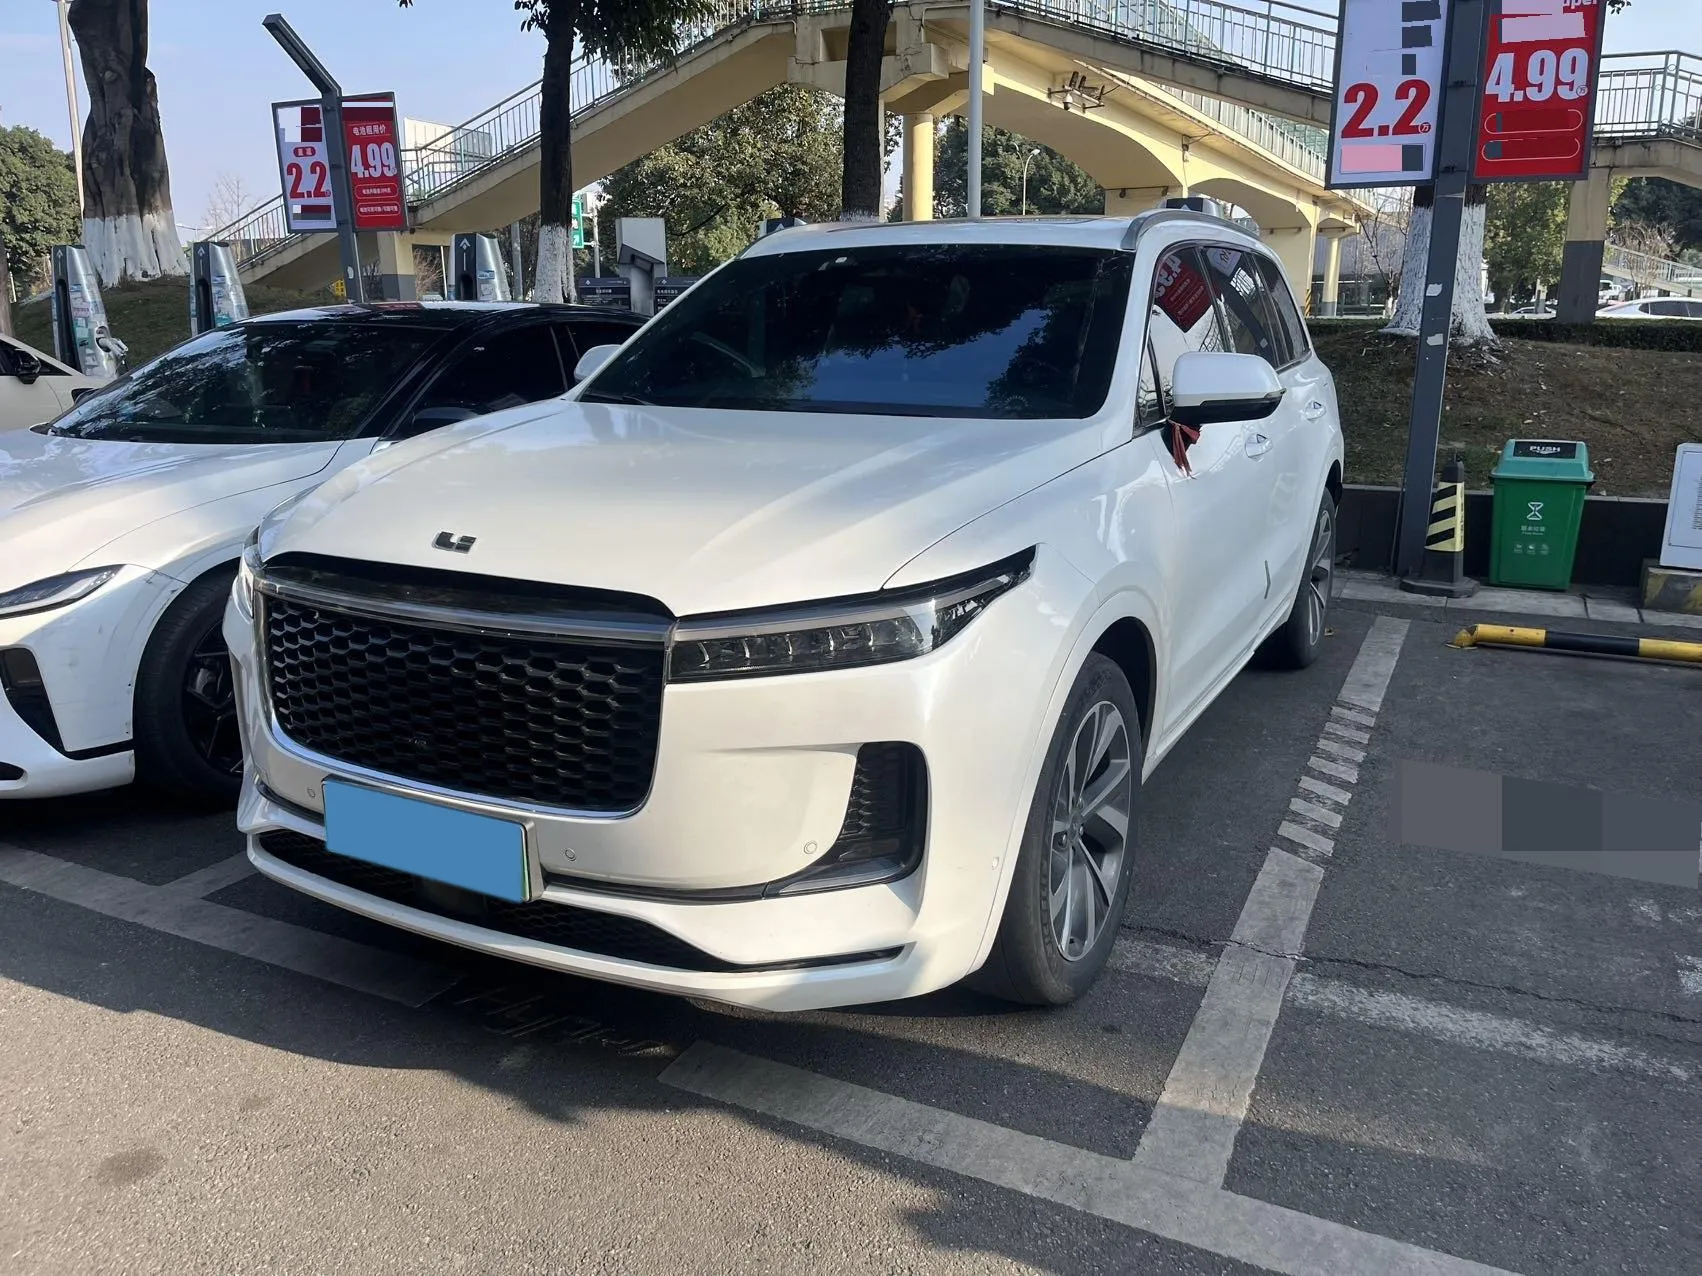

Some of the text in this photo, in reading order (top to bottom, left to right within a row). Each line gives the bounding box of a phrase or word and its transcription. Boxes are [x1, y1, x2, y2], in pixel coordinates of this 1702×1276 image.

[1485, 48, 1588, 102] 4.99
[1342, 80, 1431, 138] 2.2
[287, 161, 328, 199] 2.2
[351, 142, 395, 178] 4.99
